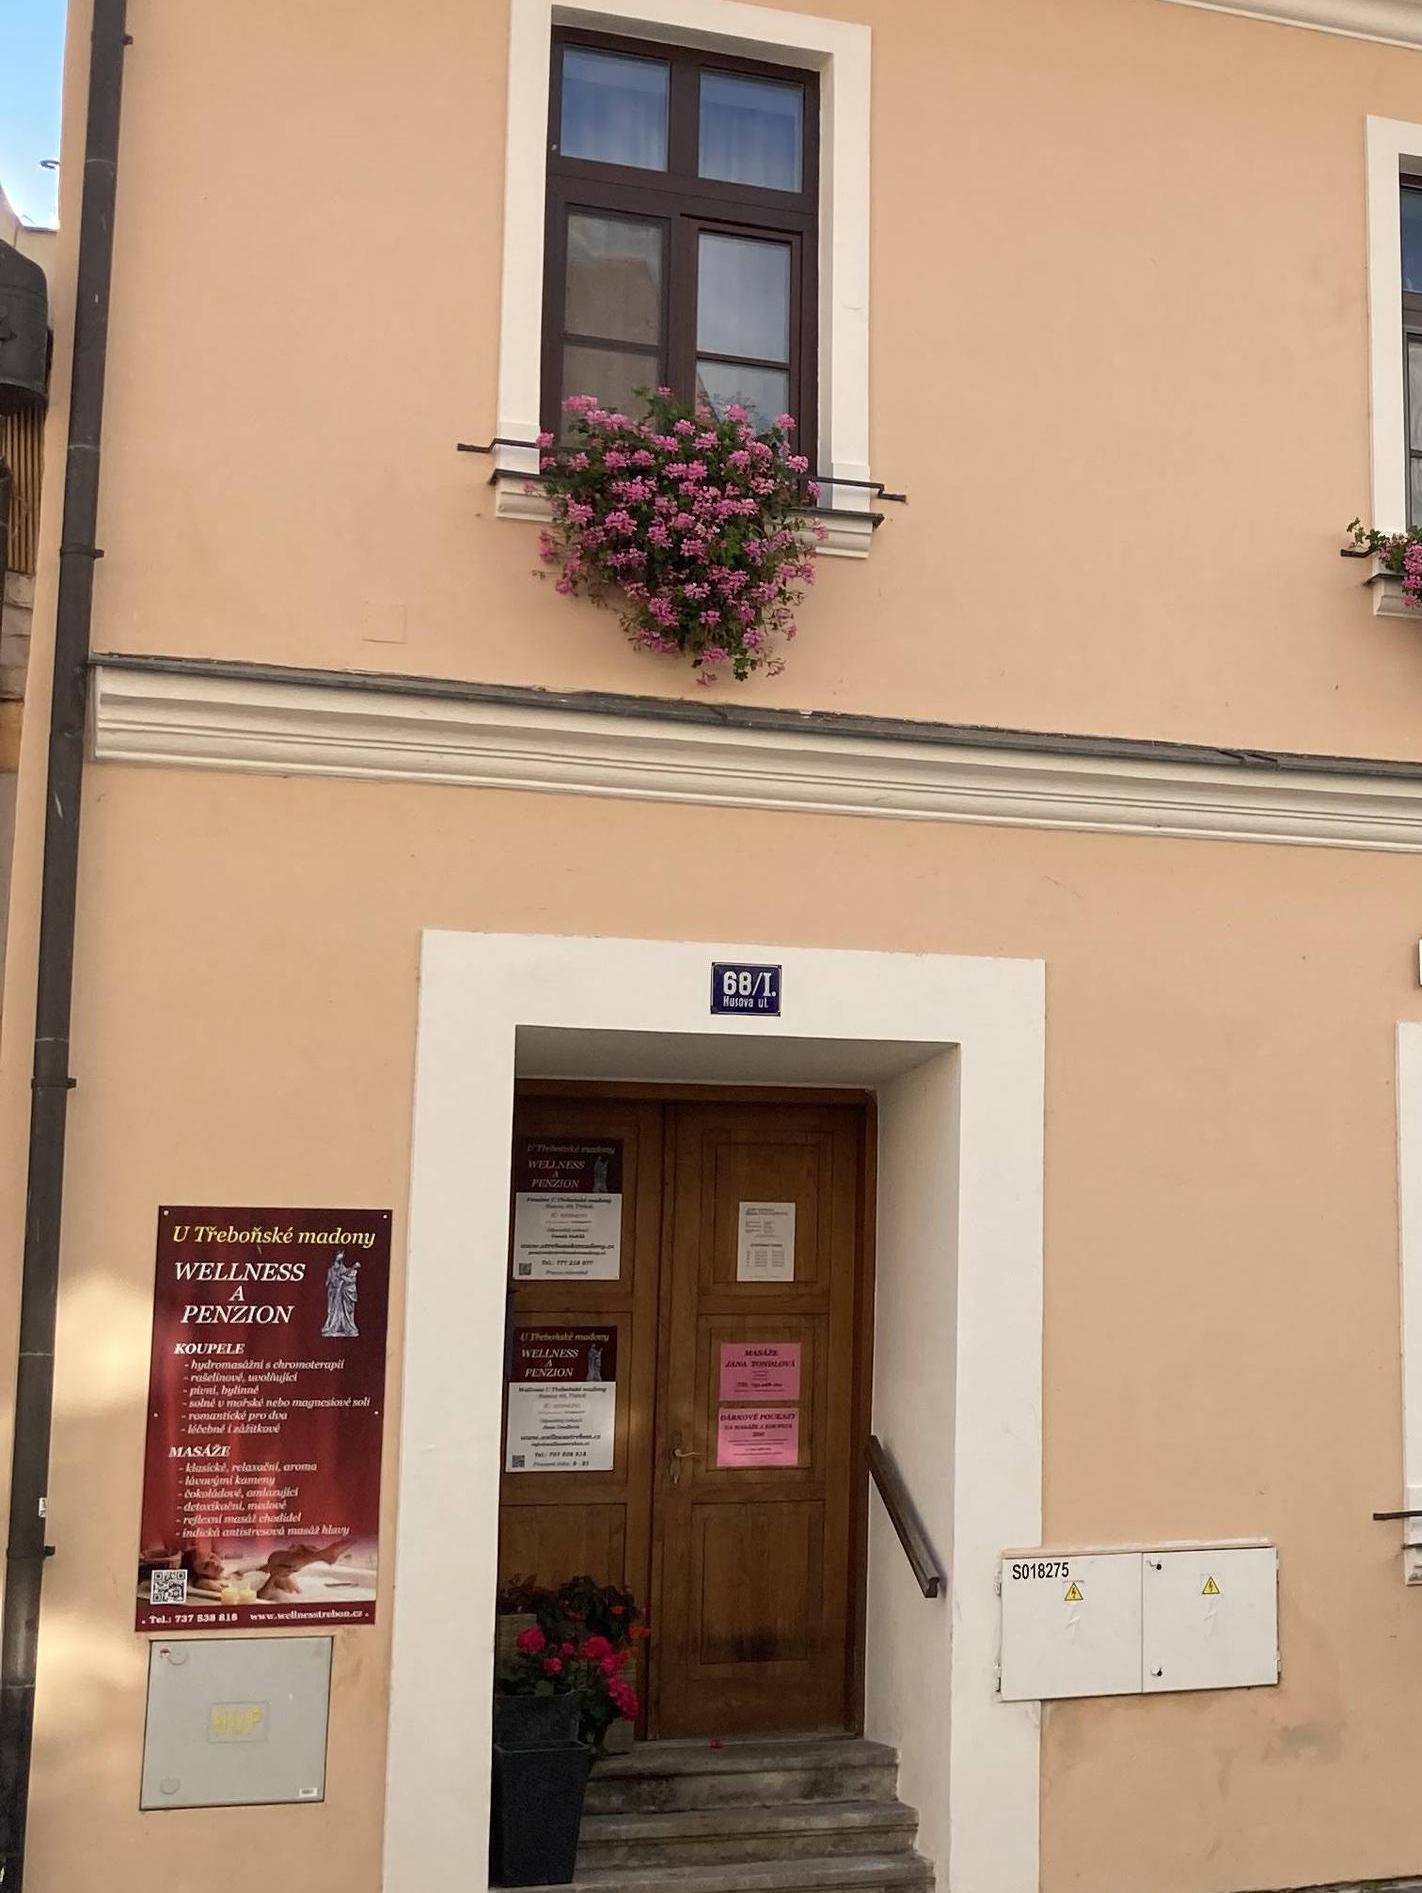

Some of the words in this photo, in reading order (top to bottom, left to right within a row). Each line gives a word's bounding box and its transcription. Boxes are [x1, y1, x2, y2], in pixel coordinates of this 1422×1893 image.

[723, 996, 754, 1008] Husova
[528, 1159, 586, 1170] WELLNESS
[531, 1178, 580, 1188] PENZION
[173, 1225, 190, 1243] U
[194, 1225, 295, 1244] Třeboňské
[298, 1227, 376, 1249] madony
[174, 1261, 306, 1282] WELLNESS
[229, 1284, 245, 1302] A
[180, 1305, 295, 1324] PENZION
[174, 1343, 245, 1355] KOUPELE
[521, 1348, 580, 1359] WELLNESS
[545, 1360, 553, 1368] A
[524, 1368, 575, 1378] PENZION
[266, 1397, 291, 1408] nebo
[188, 1410, 247, 1420] romantické
[248, 1412, 267, 1422] pro
[268, 1410, 288, 1420] dva
[168, 1444, 231, 1458] MASÁŽE
[283, 1463, 318, 1472] aroma
[234, 1475, 276, 1487] kameny
[321, 1524, 350, 1537] hlavy
[1011, 1561, 1070, 1580] S018275
[175, 1614, 194, 1623] 737
